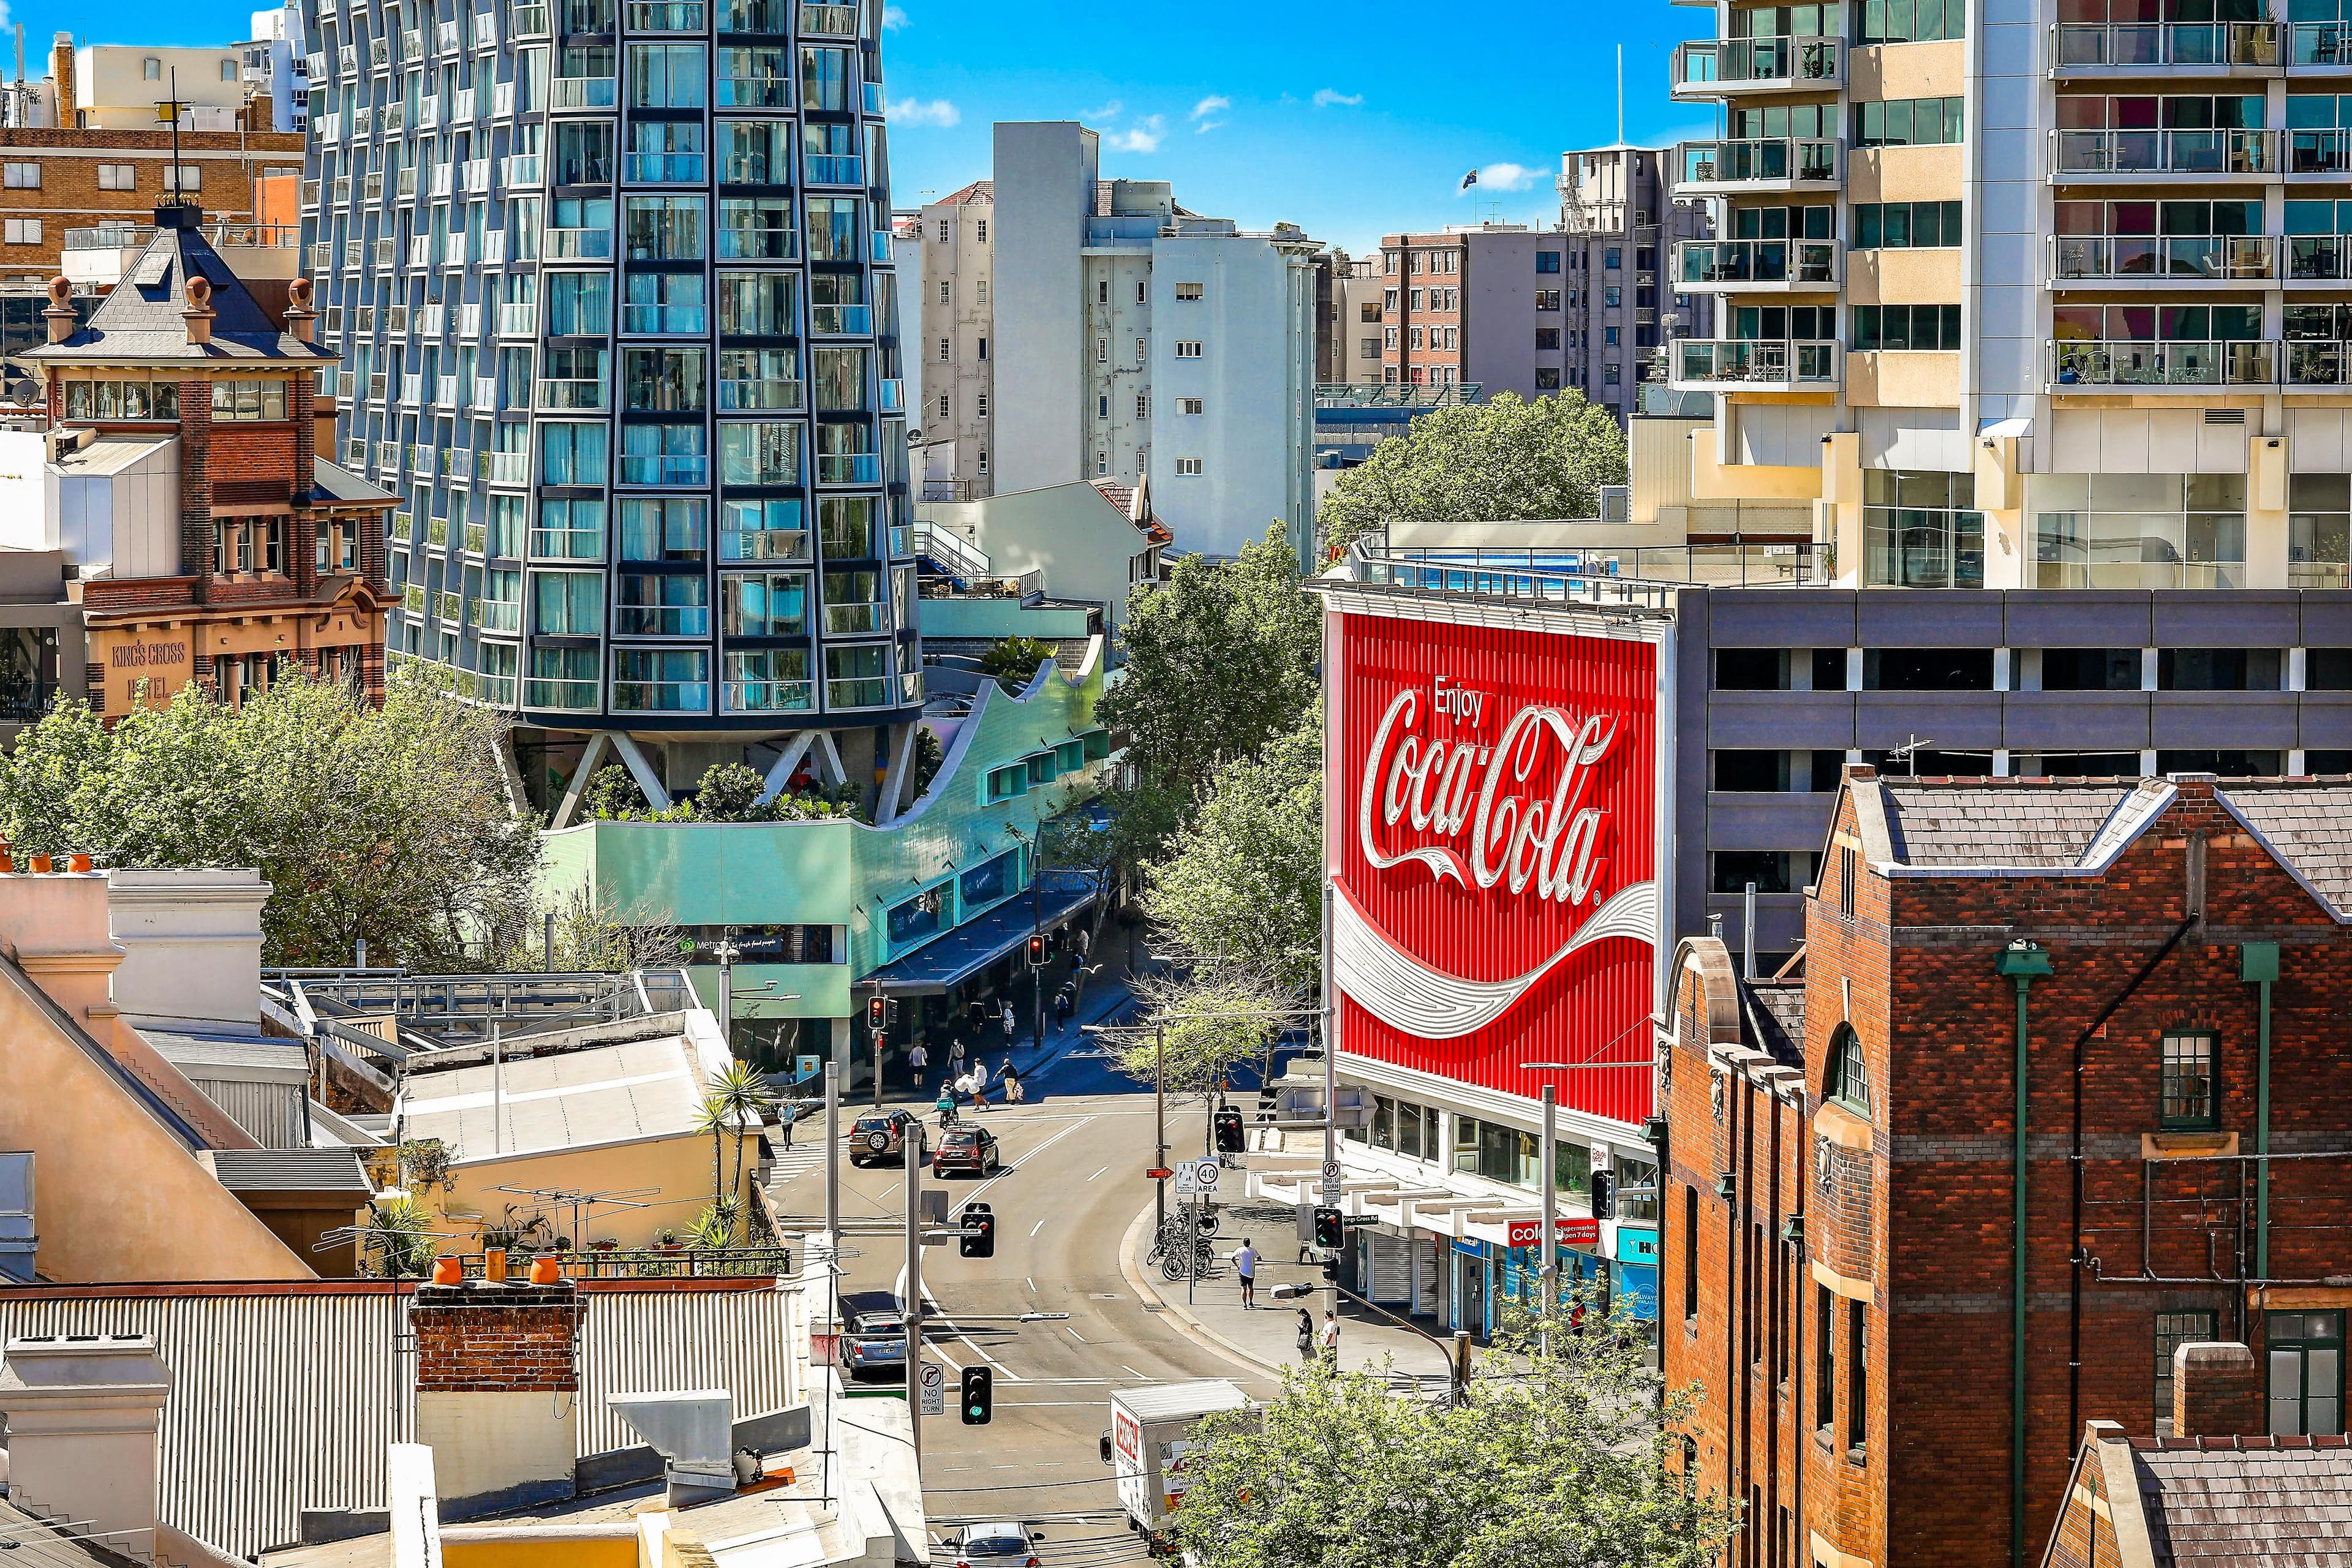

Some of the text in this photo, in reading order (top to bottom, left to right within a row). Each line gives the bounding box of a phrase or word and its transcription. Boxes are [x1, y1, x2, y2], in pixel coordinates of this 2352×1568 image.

[112, 639, 185, 667] KING'S CROSS
[127, 677, 171, 700] HTEL
[1435, 676, 1484, 728] Enjoy
[1360, 688, 1620, 907] Coca-Cola
[738, 940, 751, 950] fresh
[751, 940, 762, 948] food
[761, 938, 777, 947] people
[1200, 1169, 1216, 1178] 40
[1512, 1224, 1542, 1242] col
